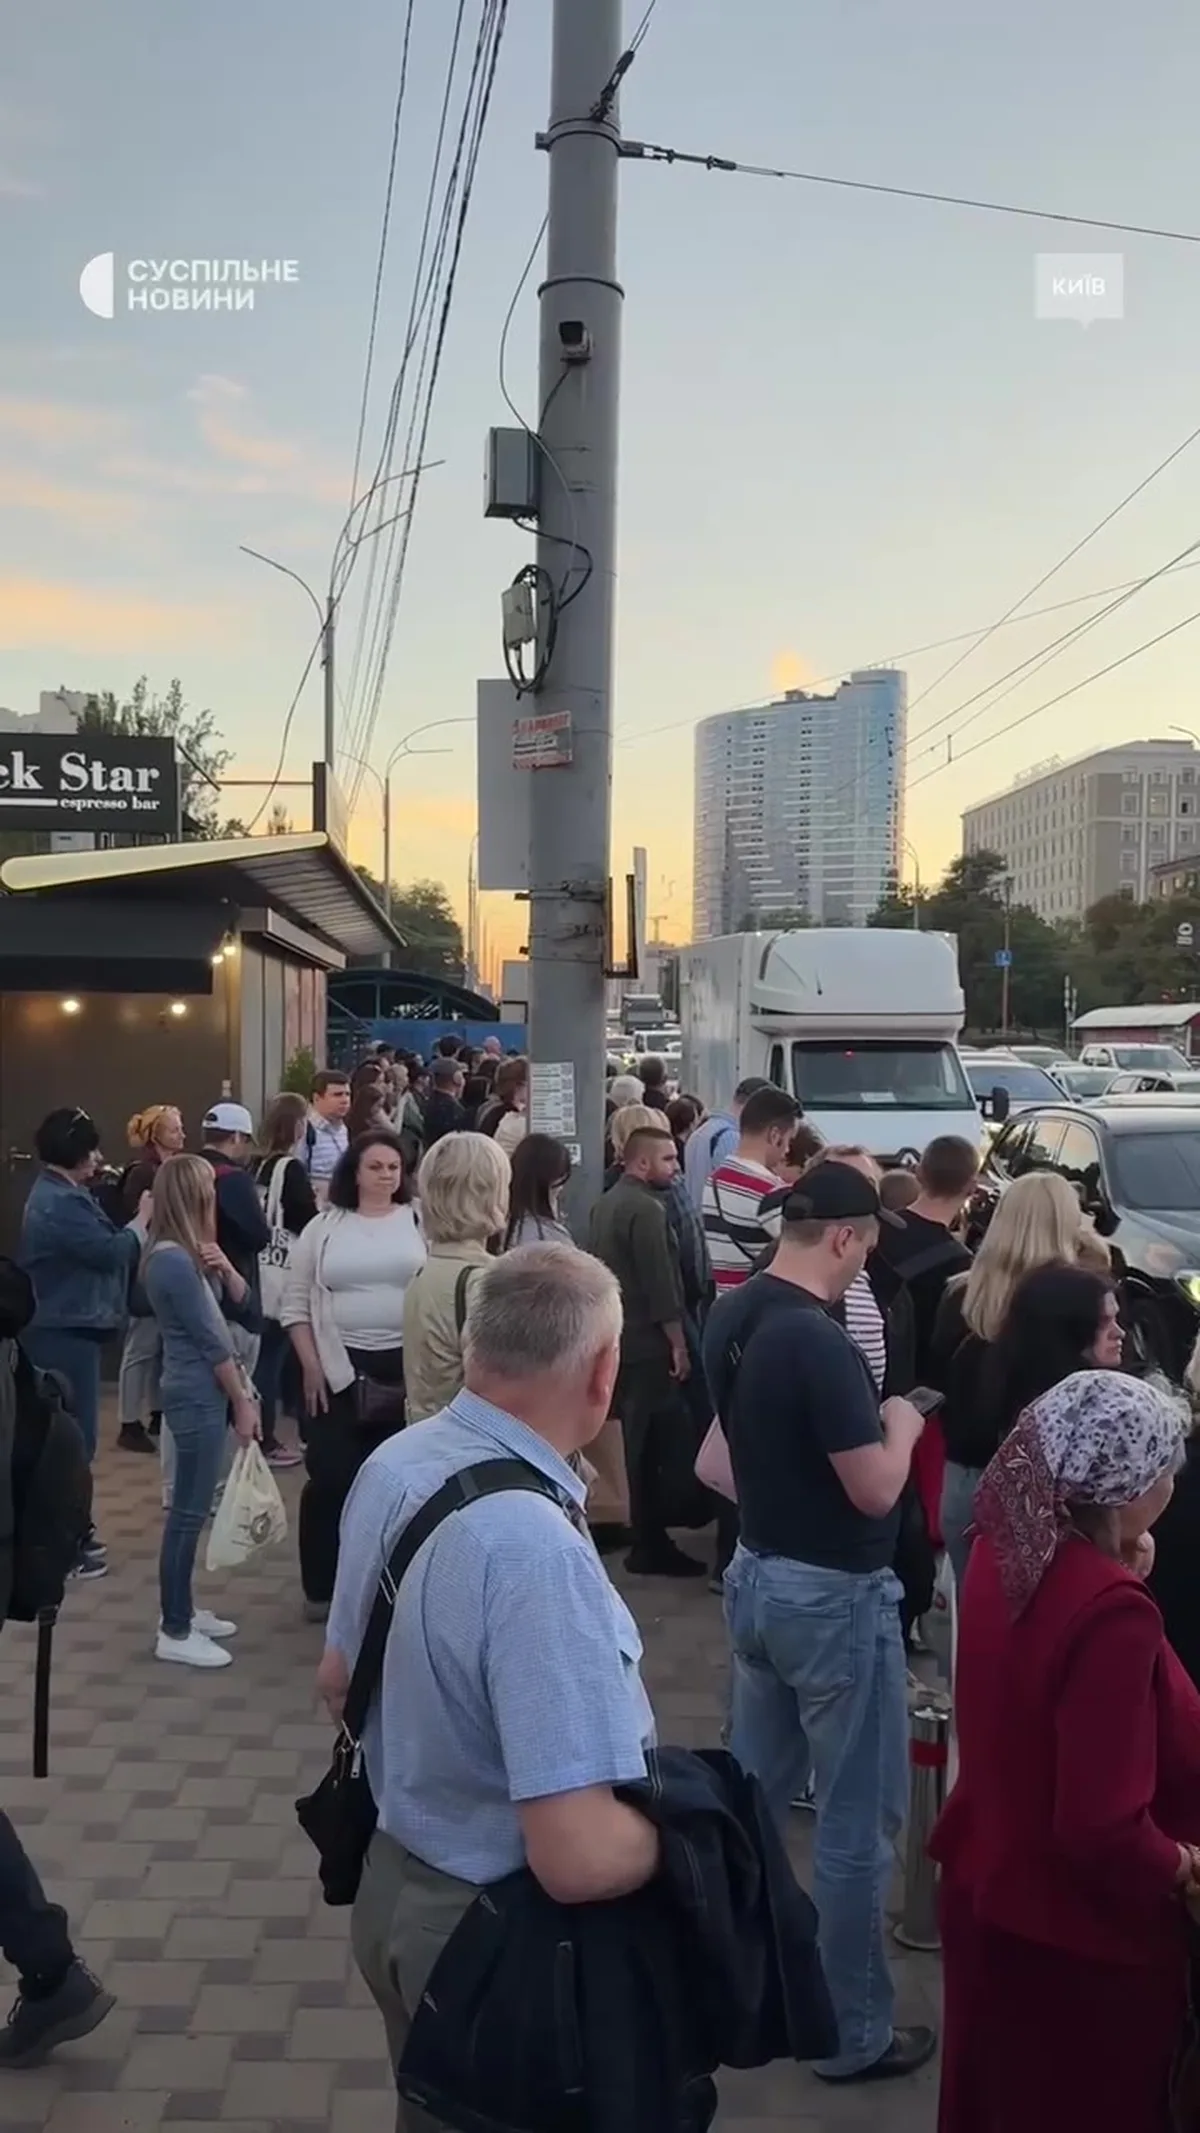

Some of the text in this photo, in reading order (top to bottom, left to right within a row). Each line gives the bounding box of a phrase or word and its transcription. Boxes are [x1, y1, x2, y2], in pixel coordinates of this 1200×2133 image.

[60, 752, 160, 792] Star
[60, 796, 160, 811] espresso bar
